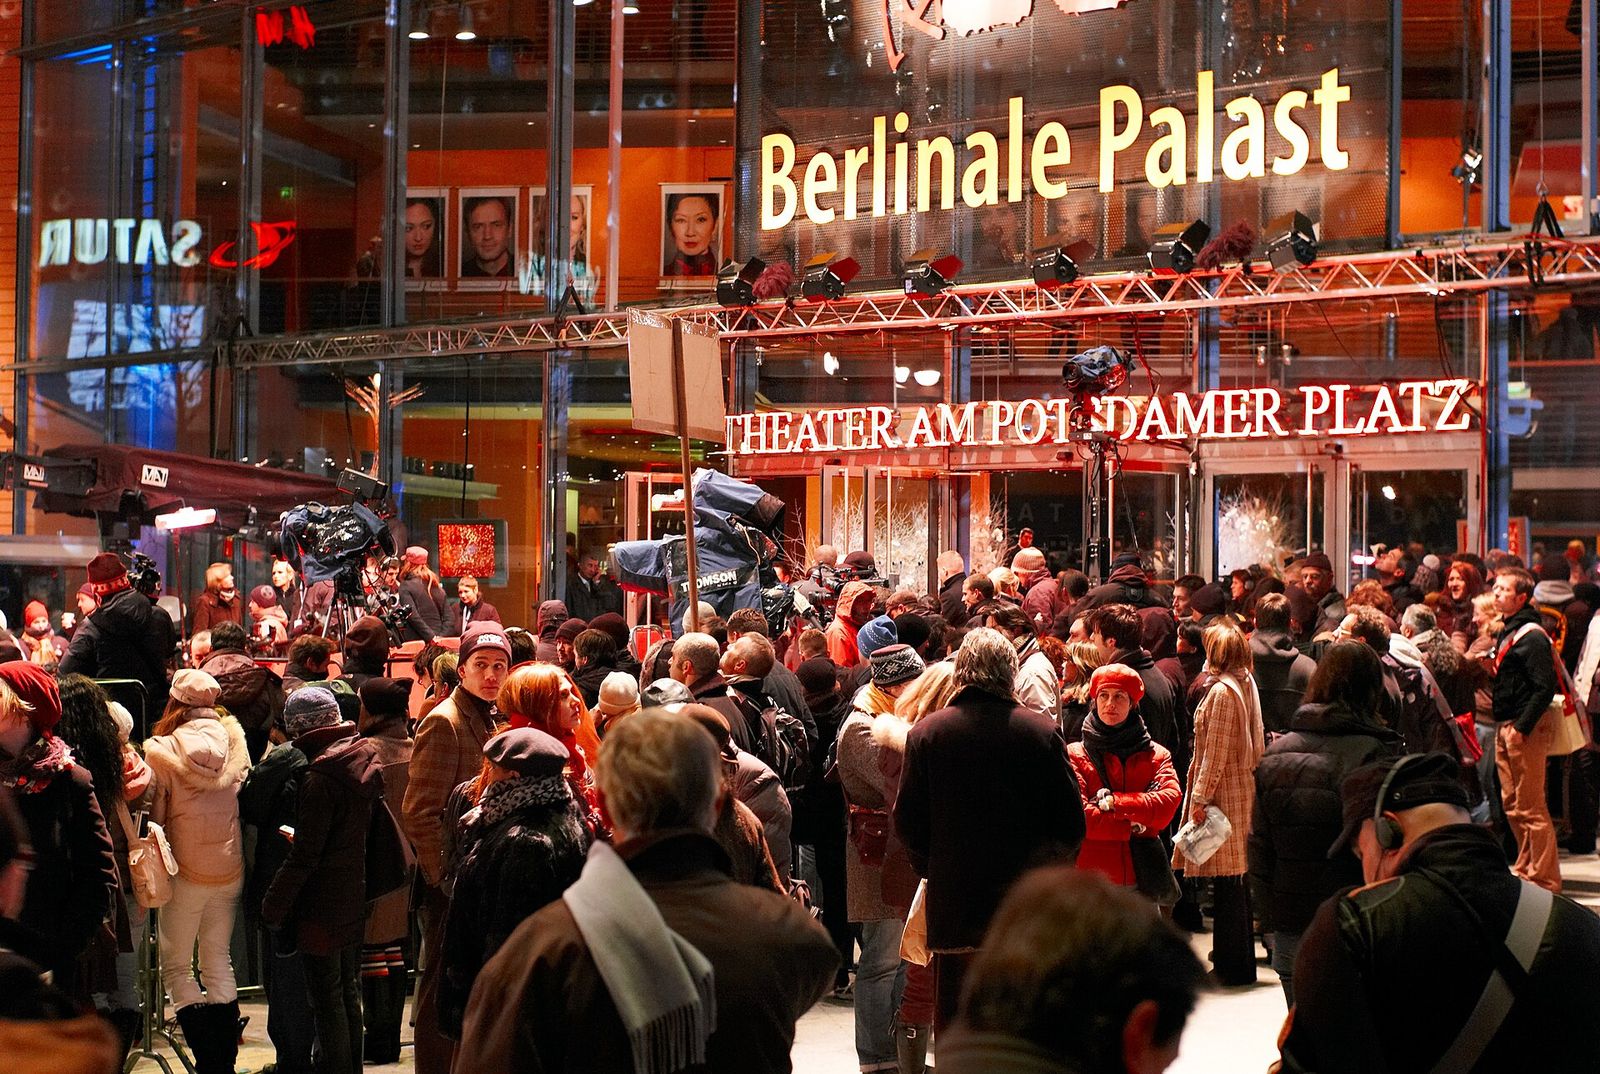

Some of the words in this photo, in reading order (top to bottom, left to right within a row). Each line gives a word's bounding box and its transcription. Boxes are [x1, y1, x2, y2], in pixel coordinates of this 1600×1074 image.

[761, 97, 1071, 230] Berlinale
[1099, 68, 1350, 192] Palast
[724, 406, 902, 454] THEATER
[905, 402, 979, 447] AM
[1298, 379, 1471, 435] PLATZ
